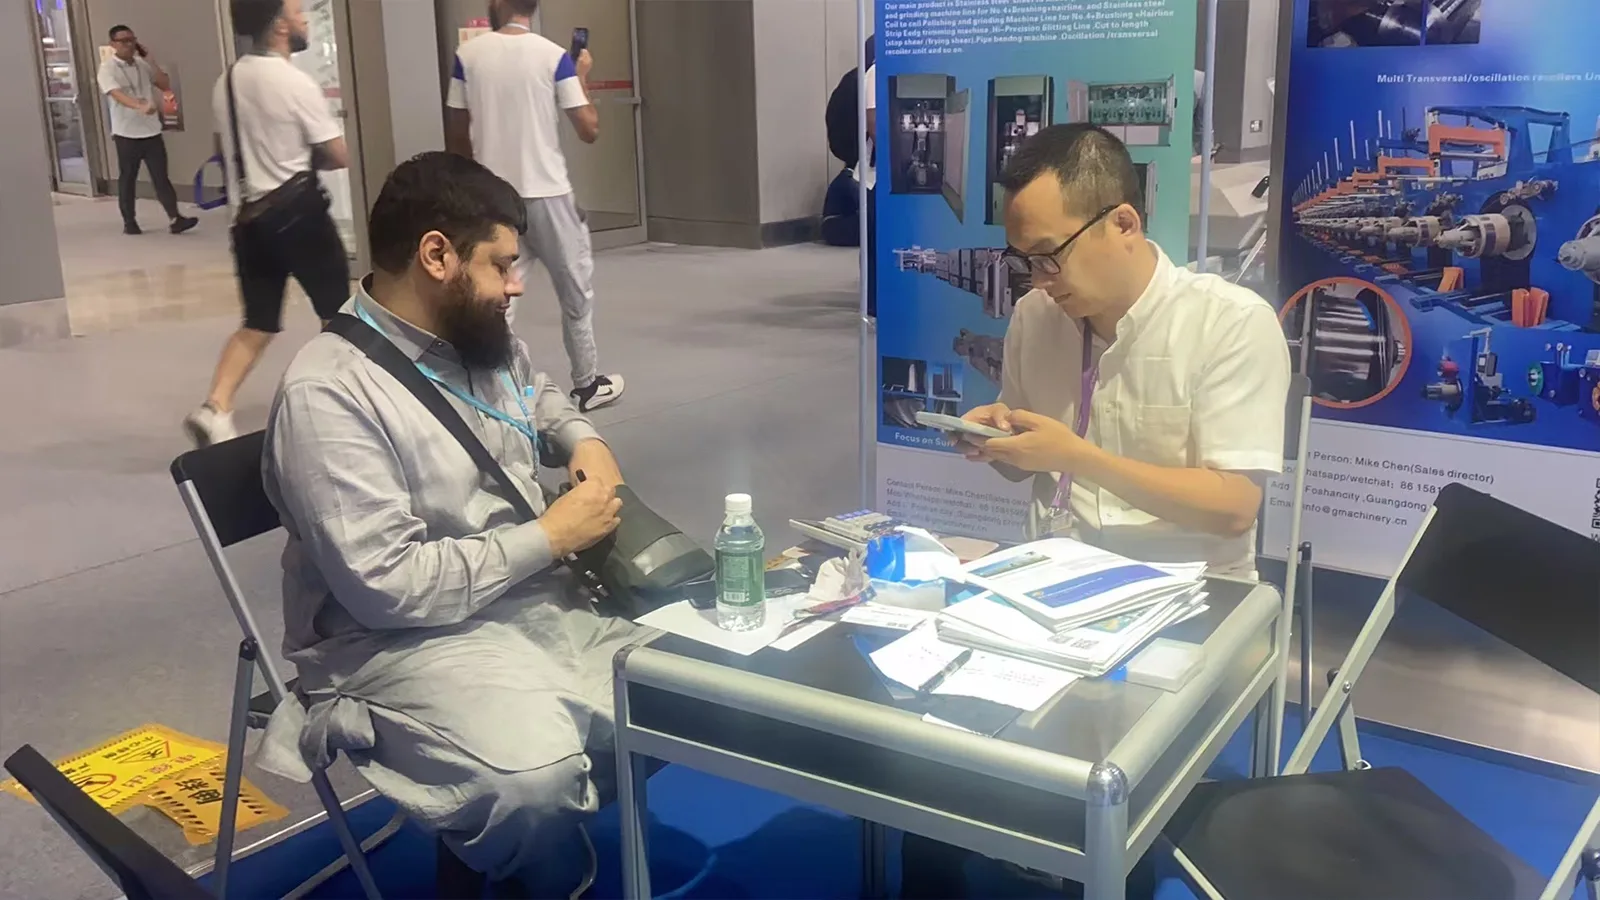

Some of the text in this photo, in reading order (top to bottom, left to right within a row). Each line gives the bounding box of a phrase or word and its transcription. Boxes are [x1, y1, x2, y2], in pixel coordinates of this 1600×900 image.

[899, 11, 928, 20] grinding
[1103, 1, 1142, 9] Stainless
[918, 1, 946, 9] product
[923, 18, 957, 27] Polishing
[973, 16, 1004, 25] grinding
[1005, 15, 1039, 23] Machine
[1058, 13, 1070, 21] for
[885, 30, 902, 38] Strip
[1073, 21, 1091, 30] Line
[1121, 20, 1149, 29] length
[1023, 33, 1057, 41] machine
[928, 46, 942, 54] and
[1377, 74, 1405, 83] Multi
[1406, 72, 1530, 83] Transversal/oscillation
[895, 432, 920, 443] Focus
[921, 437, 933, 445] on
[1313, 451, 1352, 465] Person:
[1355, 457, 1380, 469] Mike
[1382, 460, 1444, 477] Chen(Sales
[1447, 469, 1495, 485] director)
[1305, 485, 1360, 502] Foshancity
[1400, 481, 1414, 493] 86
